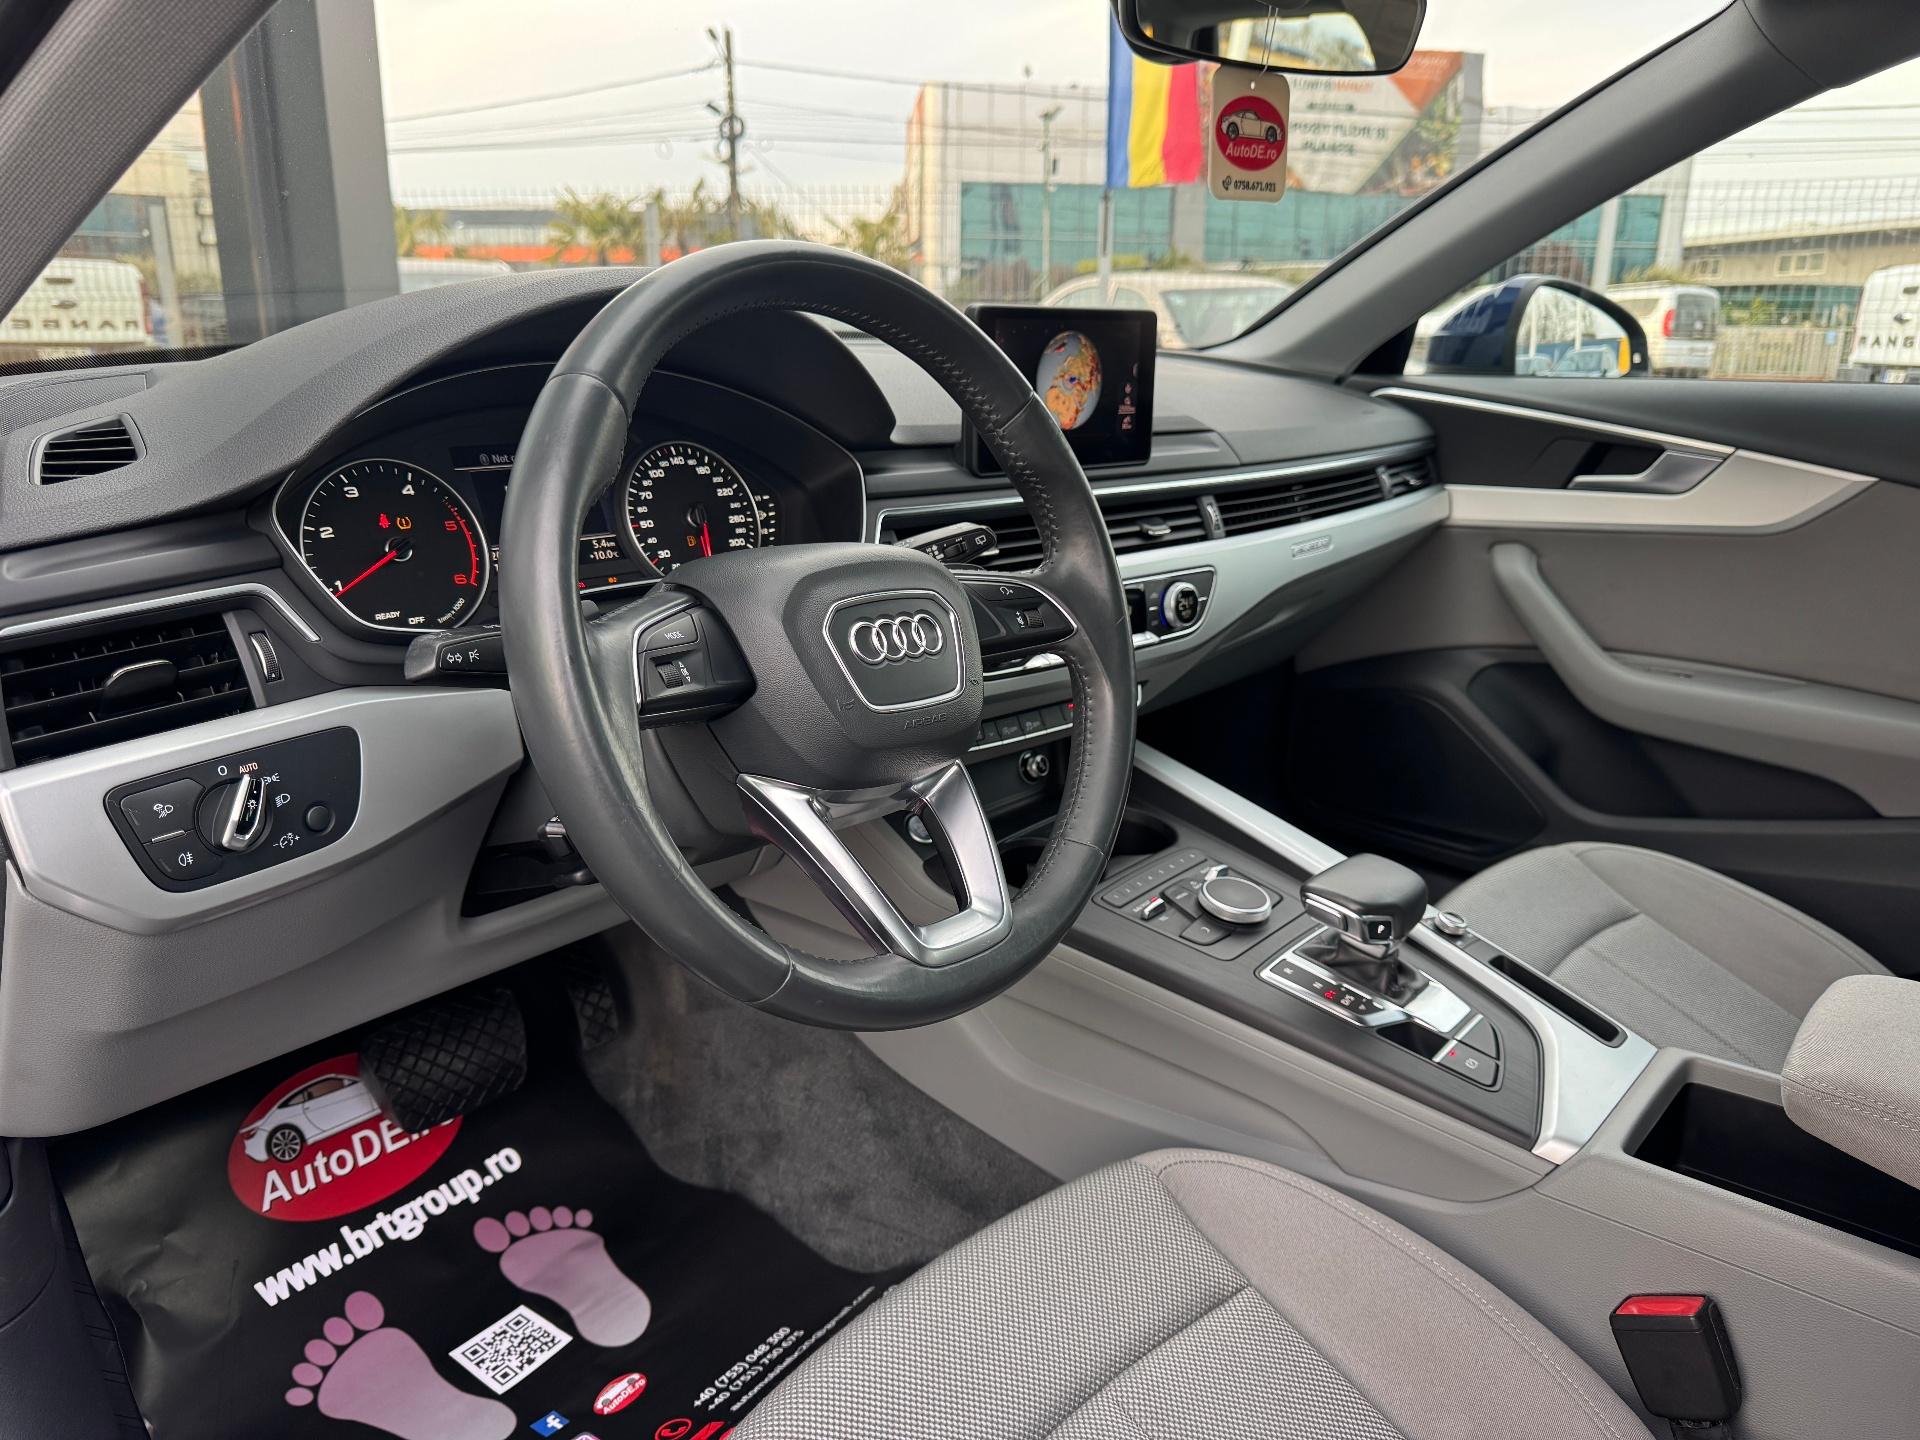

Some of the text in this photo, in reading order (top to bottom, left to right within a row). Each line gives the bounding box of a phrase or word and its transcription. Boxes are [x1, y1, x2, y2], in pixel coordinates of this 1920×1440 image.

[1225, 143, 1277, 160] AutoDE.ro
[492, 454, 511, 464] Not
[670, 456, 685, 465] 140
[648, 469, 665, 478] 100
[343, 486, 360, 498] 3
[401, 484, 415, 496] 4
[639, 491, 653, 500] 70
[717, 488, 733, 496] 220
[445, 520, 458, 532] 5
[639, 519, 654, 529] 50
[319, 527, 335, 539] 2
[728, 538, 745, 547] 300
[657, 550, 671, 558] 30
[454, 574, 467, 585] 6
[334, 580, 343, 592] 1
[375, 611, 400, 621] READY
[408, 617, 425, 625] OFF
[903, 712, 948, 731] AIRBAG
[239, 762, 258, 774] AUTO
[262, 1117, 455, 1212] AutoDE.
[253, 1147, 522, 1307] www.brtgroup.ro
